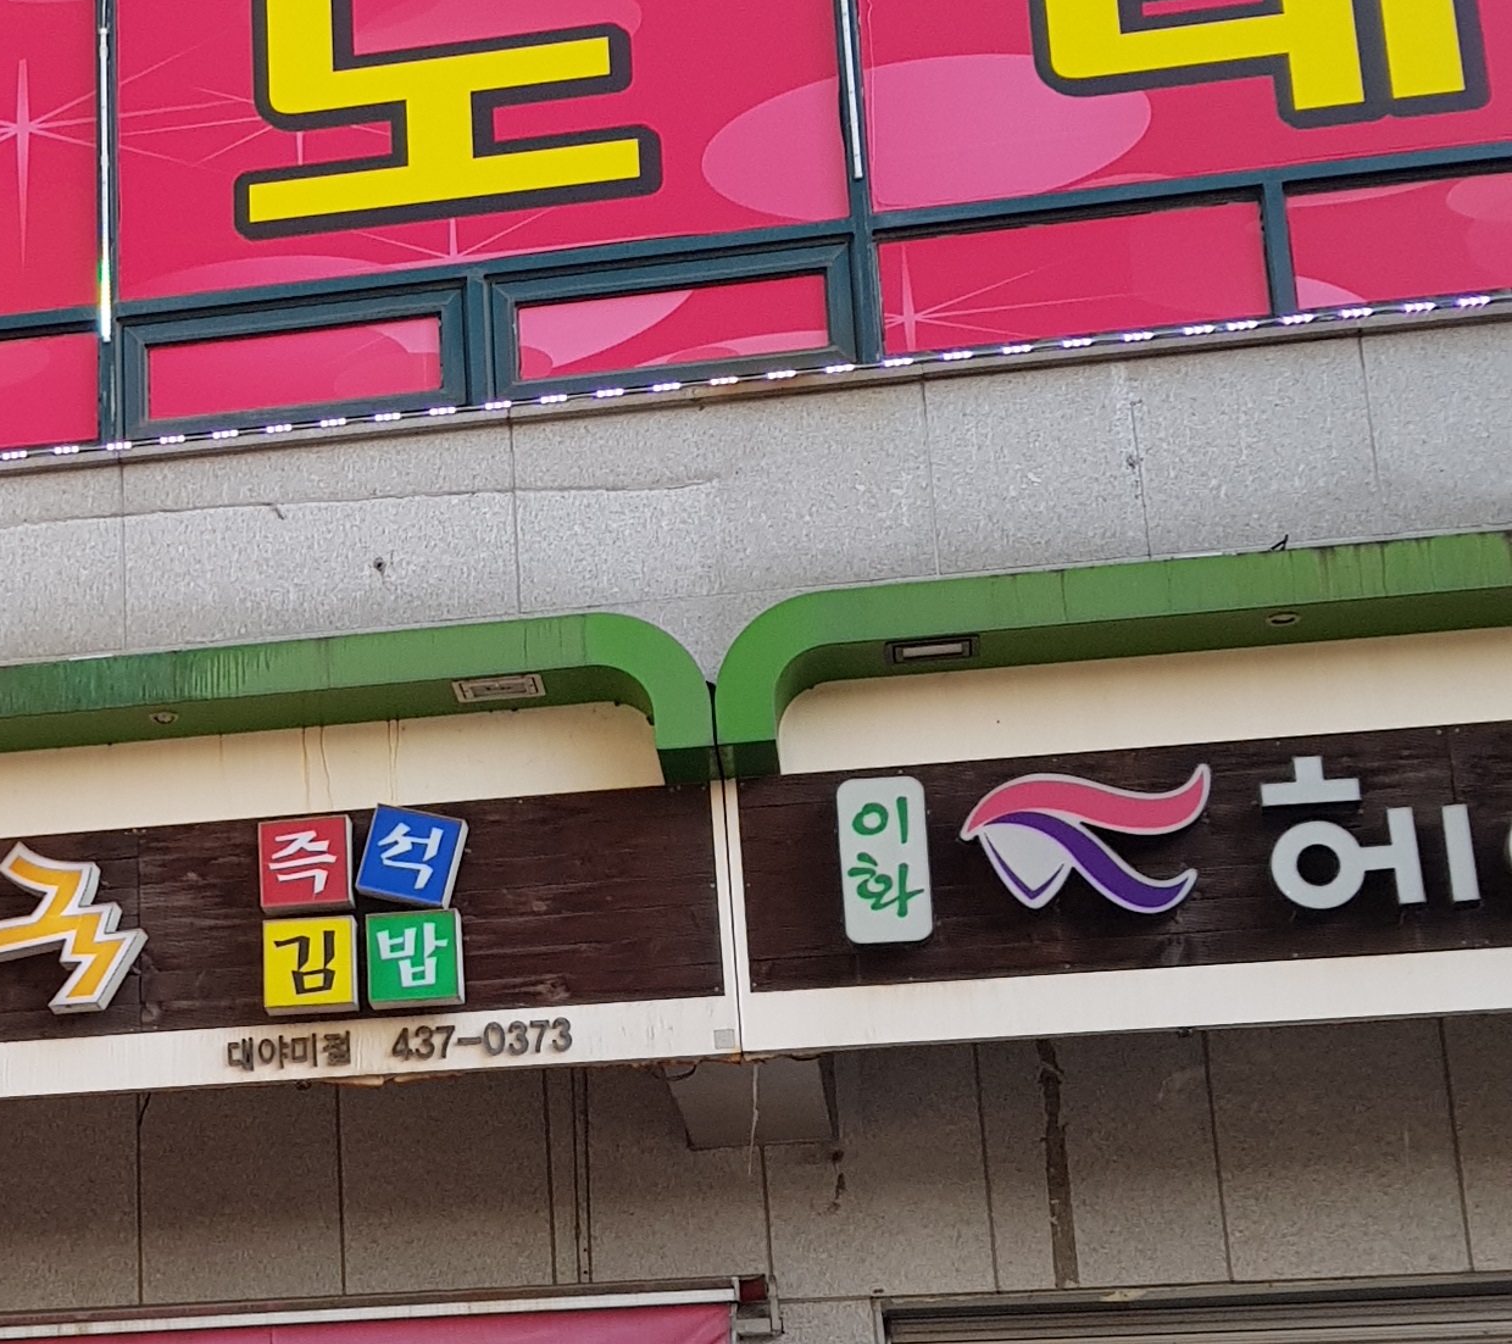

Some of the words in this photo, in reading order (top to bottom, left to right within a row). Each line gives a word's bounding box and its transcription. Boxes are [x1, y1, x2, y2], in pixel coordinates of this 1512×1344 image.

[268, 820, 444, 895] 즉석
[1260, 756, 1512, 910] 헤
[273, 927, 449, 995] 김밥
[391, 1017, 572, 1061] 437-0373
